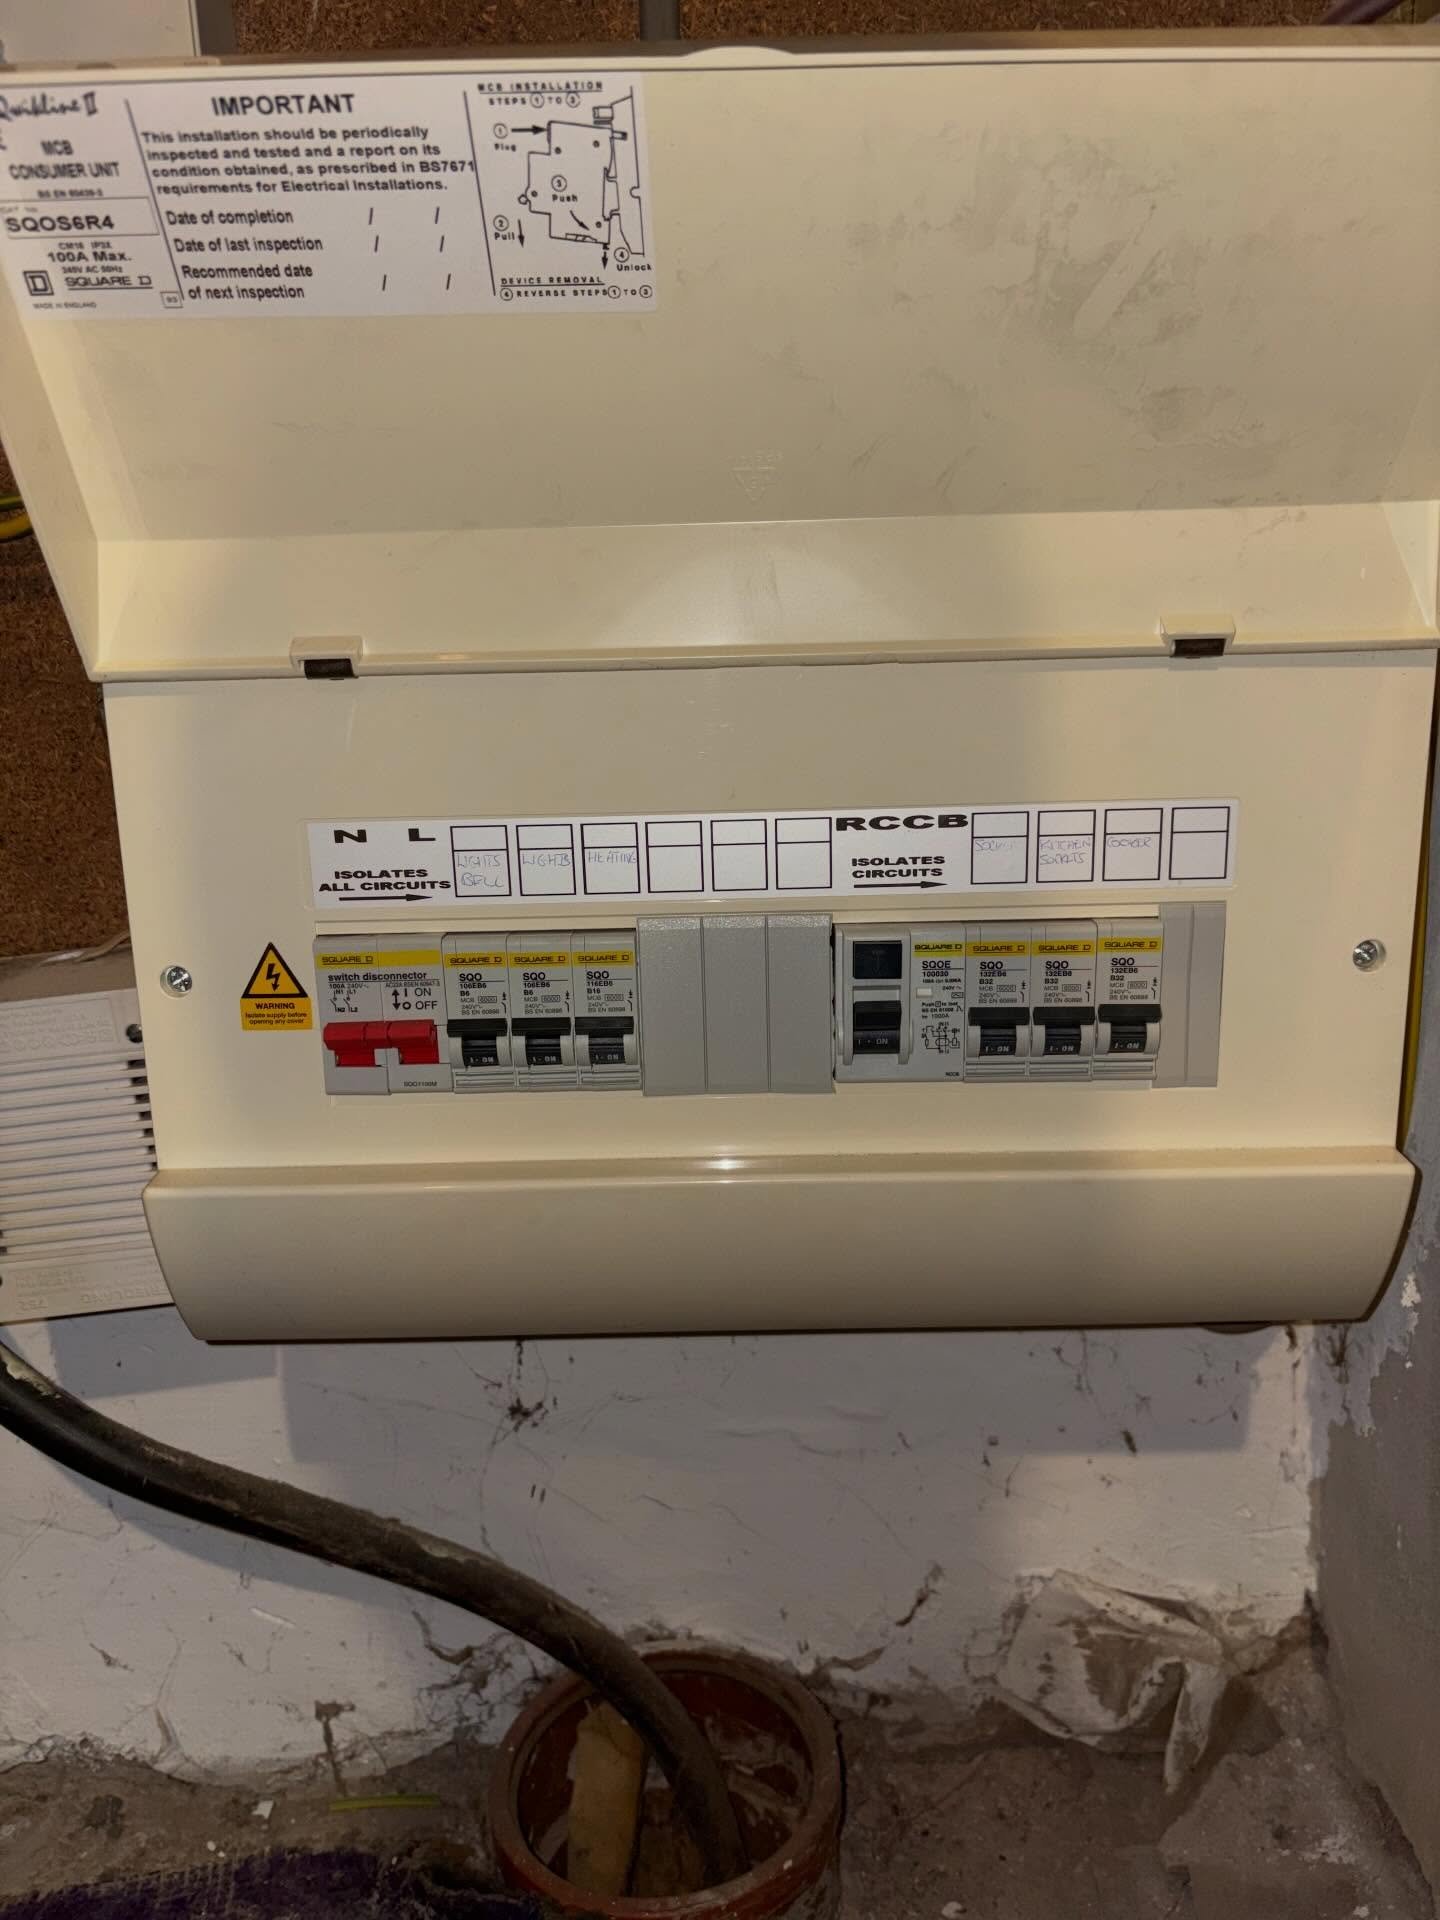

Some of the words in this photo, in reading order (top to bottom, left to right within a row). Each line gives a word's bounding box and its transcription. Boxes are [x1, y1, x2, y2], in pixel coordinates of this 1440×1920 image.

[510, 81, 603, 91] INSTALLATION
[211, 93, 355, 117] IMPORTANT
[489, 97, 527, 106] STEPS
[548, 96, 562, 105] TO
[142, 131, 174, 145] This
[178, 130, 260, 143] installation
[264, 127, 315, 141] should
[318, 127, 338, 139] be
[341, 125, 429, 142] periodically
[41, 139, 74, 156] MCB
[147, 148, 218, 163] inspected
[222, 147, 250, 160] and
[254, 146, 300, 159] tested
[305, 145, 332, 158] and
[337, 149, 345, 157] a
[350, 146, 395, 160] report
[399, 146, 418, 157] on
[421, 144, 441, 156] its
[9, 163, 86, 180] CONSUMER
[88, 161, 120, 177] UNIT
[152, 165, 220, 179] condition
[224, 163, 294, 177] obtained,
[296, 164, 314, 175] as
[318, 161, 397, 177] prescribed
[401, 161, 415, 173] in
[419, 160, 476, 174] BS7671
[156, 182, 252, 197] requirements
[256, 181, 277, 193] for
[281, 179, 350, 193] Electrical
[353, 178, 449, 192] Installations.
[552, 193, 578, 202] Push
[166, 210, 199, 226] Date
[200, 210, 215, 225] of
[218, 208, 294, 227] completion
[6, 214, 115, 233] SQOS6R4
[494, 232, 516, 241] Pull
[174, 237, 206, 253] Date
[208, 237, 223, 251] of
[225, 237, 250, 251] last
[253, 236, 324, 254] inspection
[48, 251, 88, 263] 100A
[93, 250, 132, 262] Max.
[181, 264, 281, 280] Recommended
[283, 264, 313, 278] date
[616, 263, 652, 272] Unlock
[65, 275, 132, 288] SQUARE
[138, 275, 153, 286] D
[501, 276, 542, 285] DEVICE
[549, 275, 601, 284] REMOVAL
[188, 286, 202, 300] of
[204, 286, 233, 299] next
[236, 284, 305, 301] inspection
[516, 290, 566, 298] REVERSE
[573, 289, 608, 297] STEPS
[623, 289, 637, 297] TO
[836, 814, 968, 832] RCCB
[333, 829, 367, 844] N
[408, 828, 436, 842] L
[851, 855, 945, 867] ISOLATES
[334, 869, 428, 880] ISOLATES
[851, 868, 943, 879] CIRCUITS
[319, 882, 355, 892] ALL
[360, 880, 451, 892] CIRCUITS
[954, 943, 963, 951] D
[1038, 944, 1078, 952] SQUARE
[321, 955, 361, 963] SQUARE
[365, 955, 374, 963] D
[450, 956, 490, 964] SQUARE
[578, 954, 617, 962] SQUARE
[1111, 957, 1135, 966] SQO
[979, 961, 1003, 970] SQO
[1045, 960, 1069, 970] SQO
[328, 973, 360, 982] switch
[363, 971, 427, 982] disconnector
[459, 972, 482, 982] SQO
[523, 971, 546, 981] SQO
[586, 970, 609, 980] SQO
[1044, 977, 1059, 985] B32
[414, 987, 432, 997] ON
[254, 1002, 296, 1010] WARNING
[415, 1000, 438, 1010] OFF
